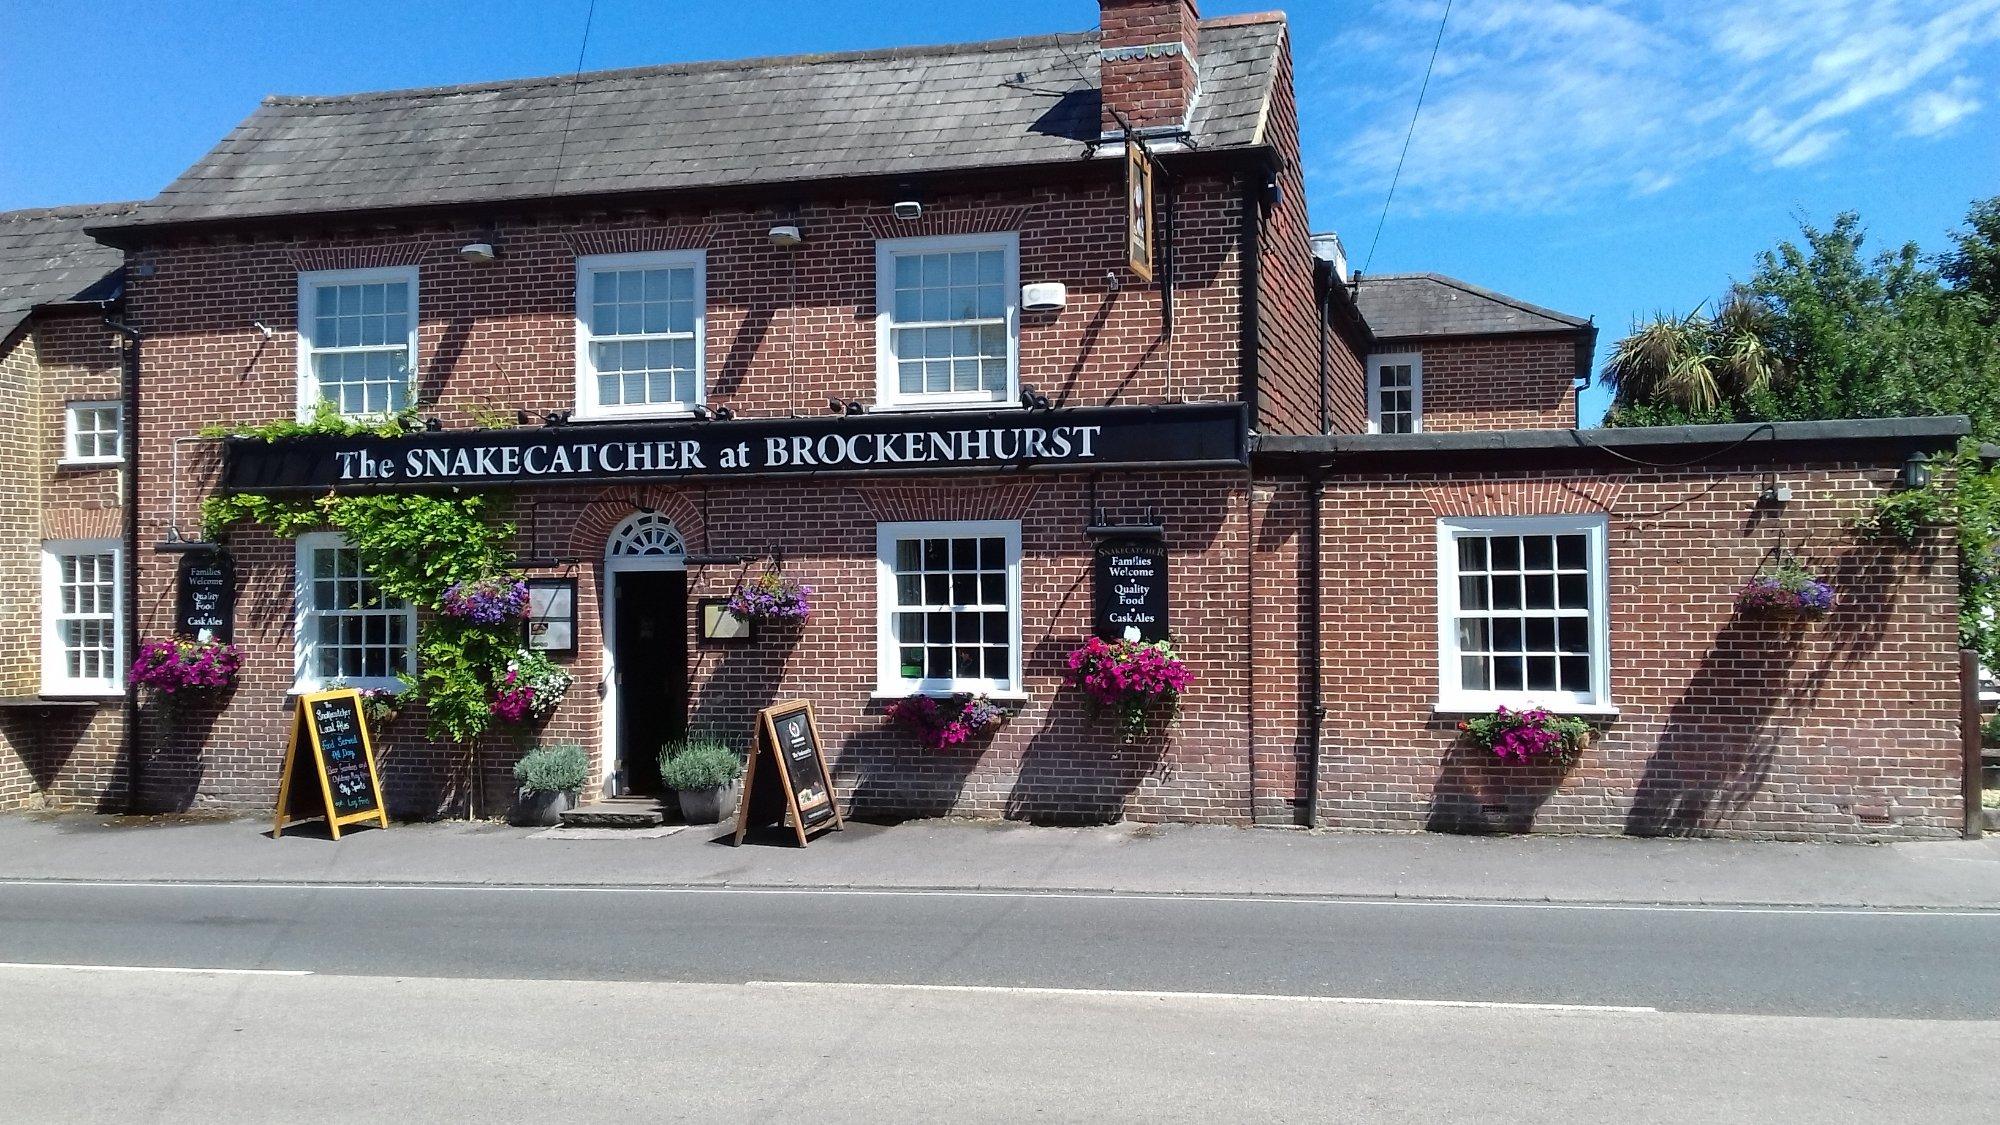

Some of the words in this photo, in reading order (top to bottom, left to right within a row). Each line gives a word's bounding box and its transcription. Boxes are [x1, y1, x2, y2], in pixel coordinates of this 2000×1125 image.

[336, 451, 396, 479] The
[405, 440, 707, 478] SNAKECATCHER
[719, 441, 750, 468] at
[764, 425, 1101, 467] BROCKENHURST
[1112, 556, 1151, 566] Families
[191, 568, 221, 576] Families
[1109, 567, 1154, 576] Welcome
[189, 577, 223, 585] Welcome
[1114, 584, 1150, 596] Quality
[192, 592, 219, 602] Quality
[1119, 595, 1144, 605] Food
[195, 602, 215, 610] Food
[187, 617, 206, 626] Cask
[206, 617, 223, 626] Ales
[1109, 613, 1133, 622] Cask
[1134, 613, 1155, 622] Ales
